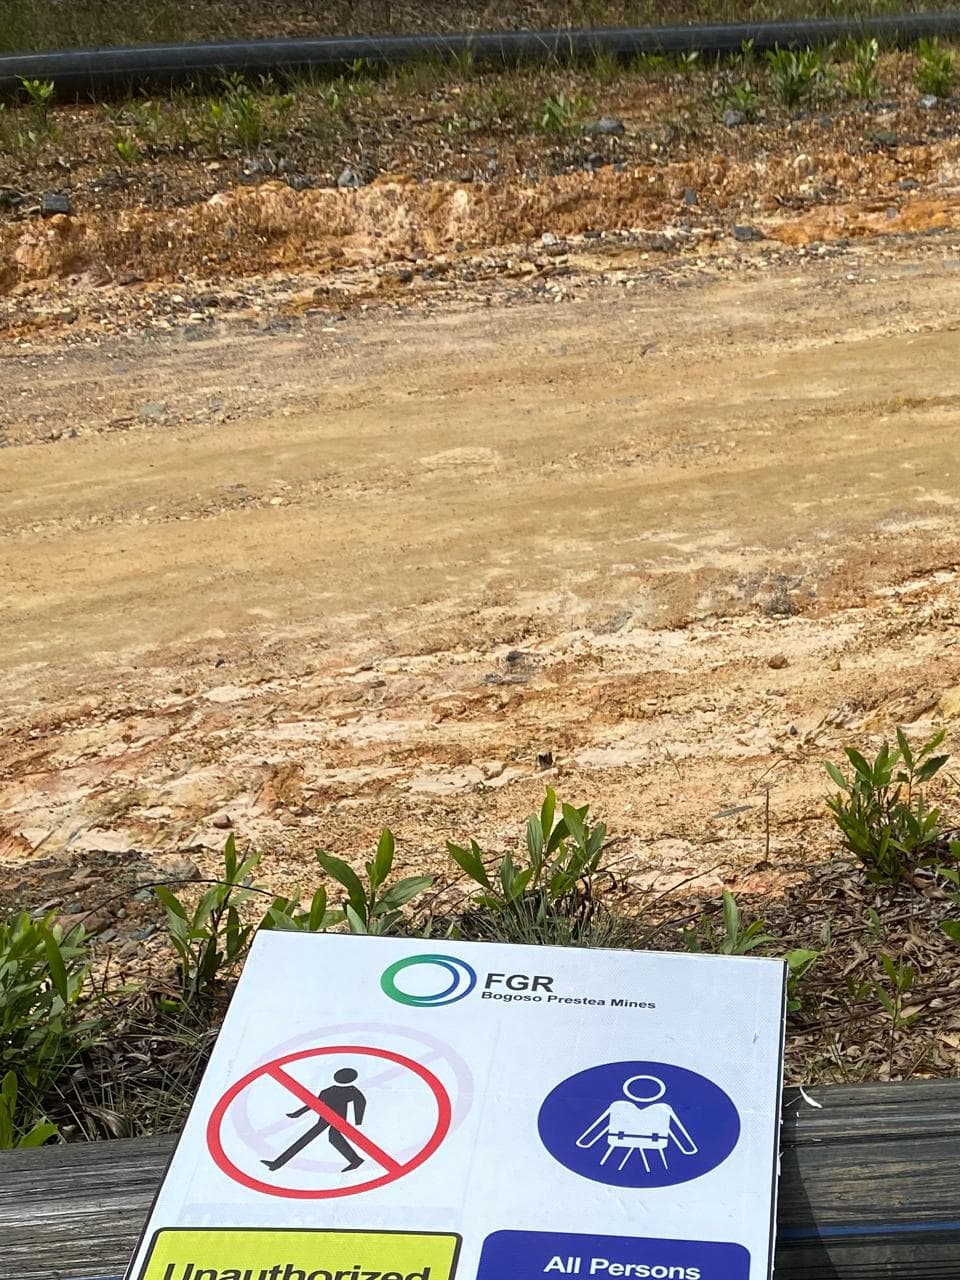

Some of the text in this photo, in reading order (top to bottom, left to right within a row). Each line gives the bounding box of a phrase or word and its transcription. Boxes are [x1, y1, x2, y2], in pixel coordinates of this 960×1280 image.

[484, 973, 554, 992] FGR
[481, 991, 656, 1009] Bogoso Prestea Mines
[543, 1255, 701, 1280] All Persons
